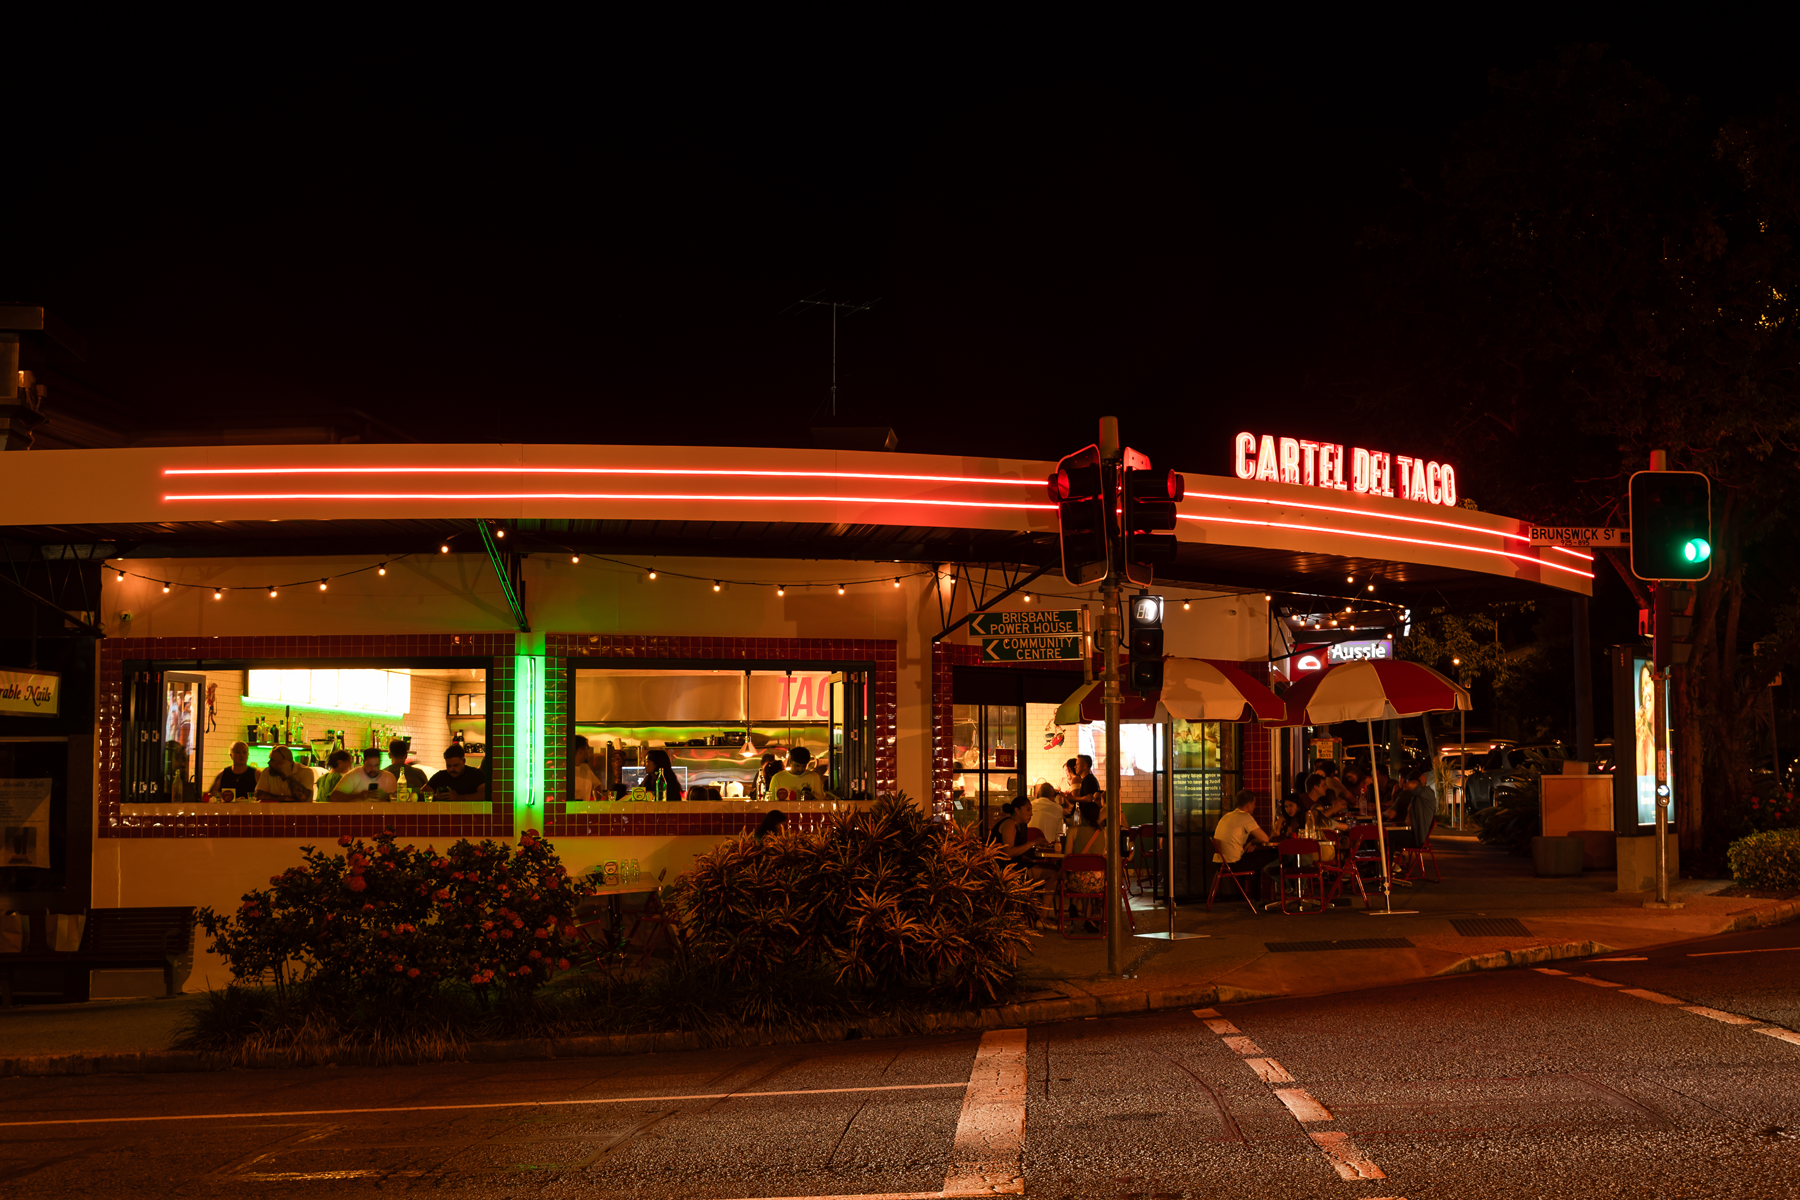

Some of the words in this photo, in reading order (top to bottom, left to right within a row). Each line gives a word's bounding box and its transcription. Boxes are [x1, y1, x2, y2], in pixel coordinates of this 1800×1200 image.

[1235, 431, 1348, 491] CARTEL
[1352, 447, 1395, 498] DEL
[1397, 455, 1457, 507] TACO
[1531, 528, 1599, 540] BRUNSWICK
[1603, 528, 1616, 540] ST
[1002, 611, 1060, 623] BRISBANE
[990, 623, 1030, 635] POWER
[1033, 621, 1073, 633] HOUSE
[1003, 637, 1073, 649] COMMUNITY
[1016, 648, 1062, 660] CENTRE
[1331, 643, 1386, 660] Aussie
[24, 685, 52, 707] Nails
[777, 676, 829, 717] TAC
